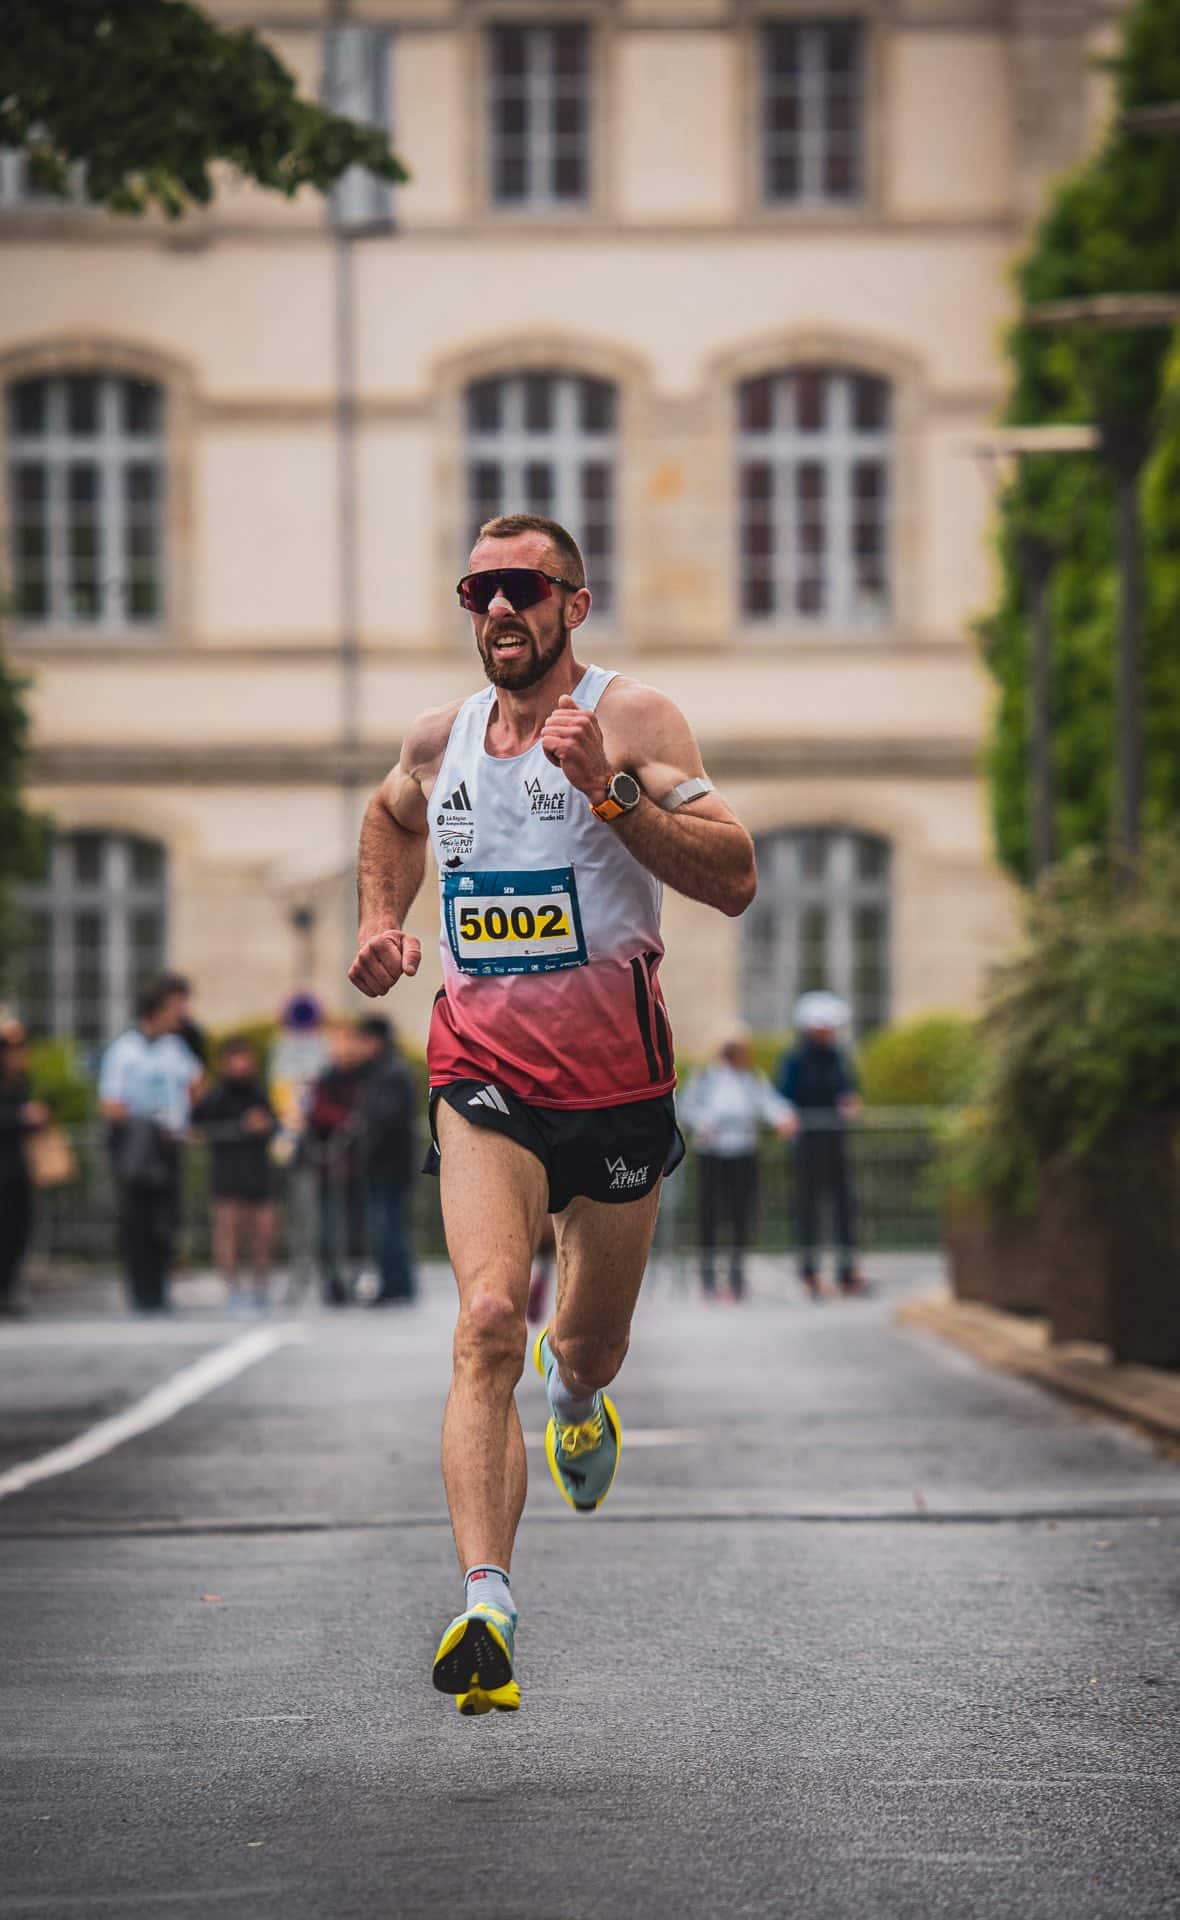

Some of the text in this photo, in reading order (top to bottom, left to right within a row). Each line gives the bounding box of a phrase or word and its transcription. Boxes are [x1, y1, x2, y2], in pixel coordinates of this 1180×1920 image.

[532, 793, 565, 801] VELAY
[531, 800, 565, 811] ATHLE
[460, 839, 473, 847] PUY
[460, 905, 568, 941] 5002
